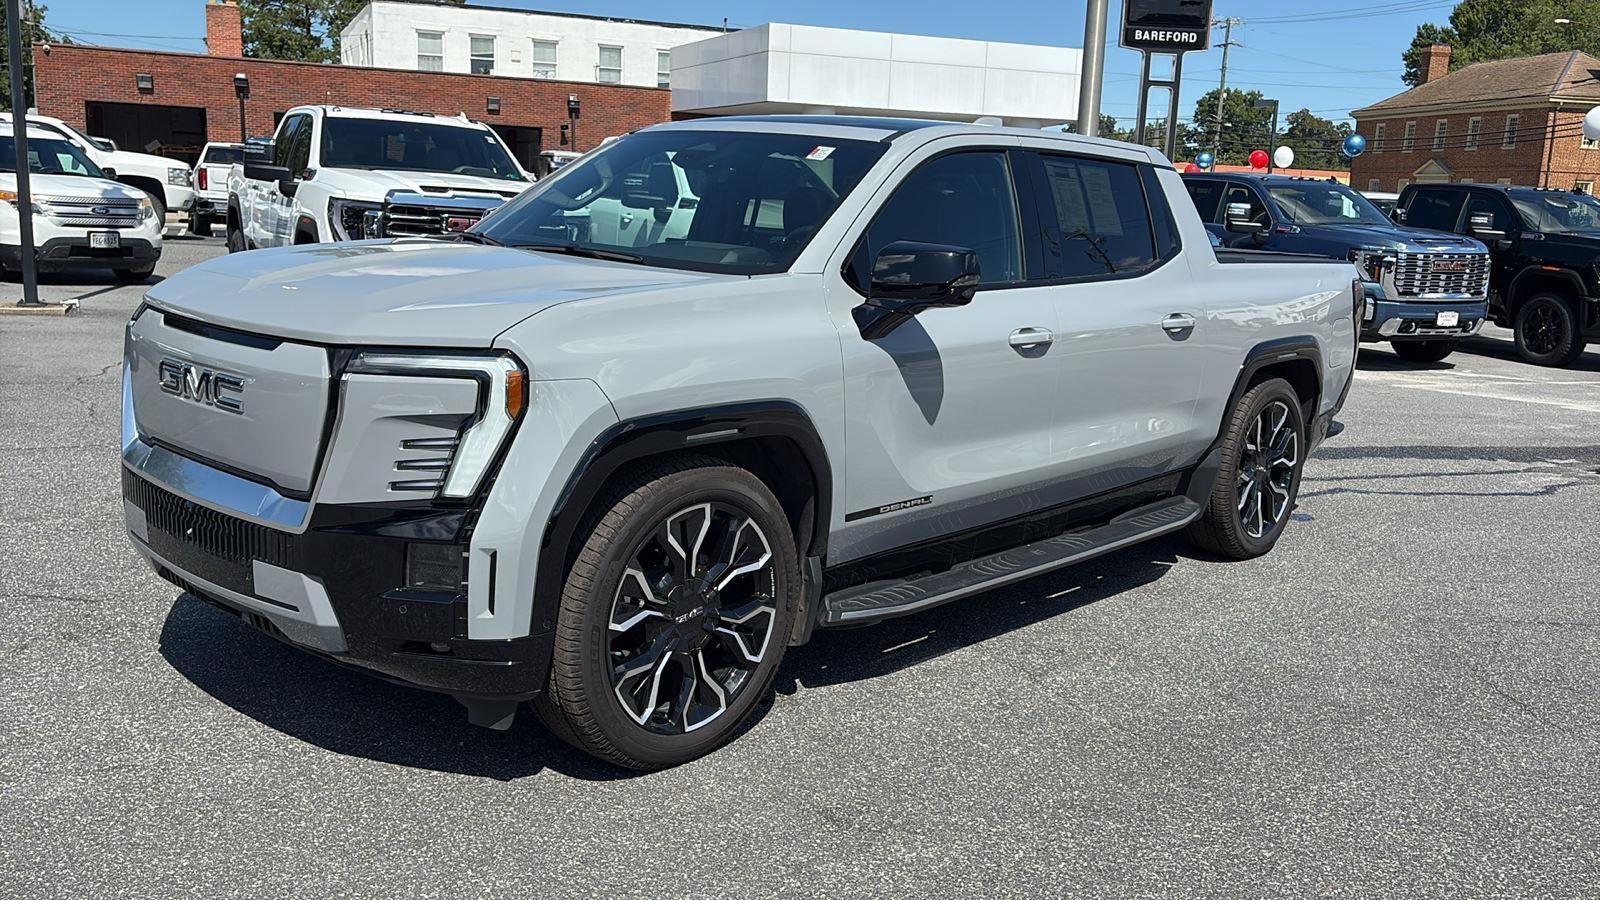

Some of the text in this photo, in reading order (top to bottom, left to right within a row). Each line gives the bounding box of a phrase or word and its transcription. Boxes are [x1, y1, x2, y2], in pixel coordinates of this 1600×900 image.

[1135, 30, 1197, 43] BAREFORD
[159, 358, 245, 415] GMC
[880, 496, 933, 513] DENALI
